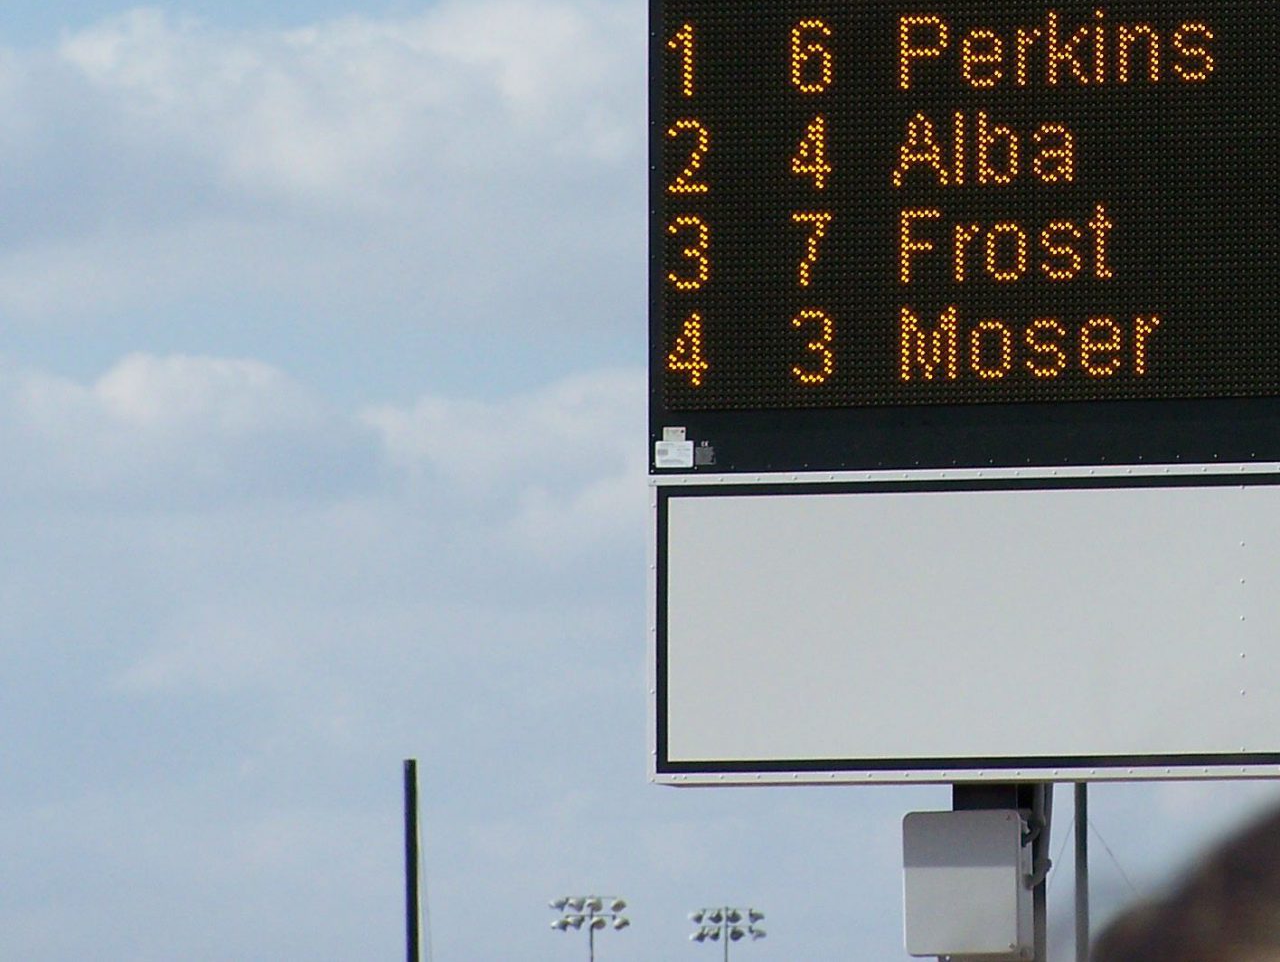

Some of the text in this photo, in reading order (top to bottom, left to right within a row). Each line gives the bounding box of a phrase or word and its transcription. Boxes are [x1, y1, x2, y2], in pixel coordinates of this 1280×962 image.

[668, 24, 693, 97] 1
[791, 19, 832, 93] 6
[899, 10, 1214, 90] Perkins
[668, 120, 708, 194] 2
[792, 116, 832, 189] 4
[893, 111, 1073, 187] Alba
[668, 216, 708, 290] 3
[792, 212, 832, 286] 7
[900, 204, 1113, 283] Frost
[667, 313, 708, 386] 4
[792, 310, 833, 383] 3
[900, 306, 1160, 381] Moser
